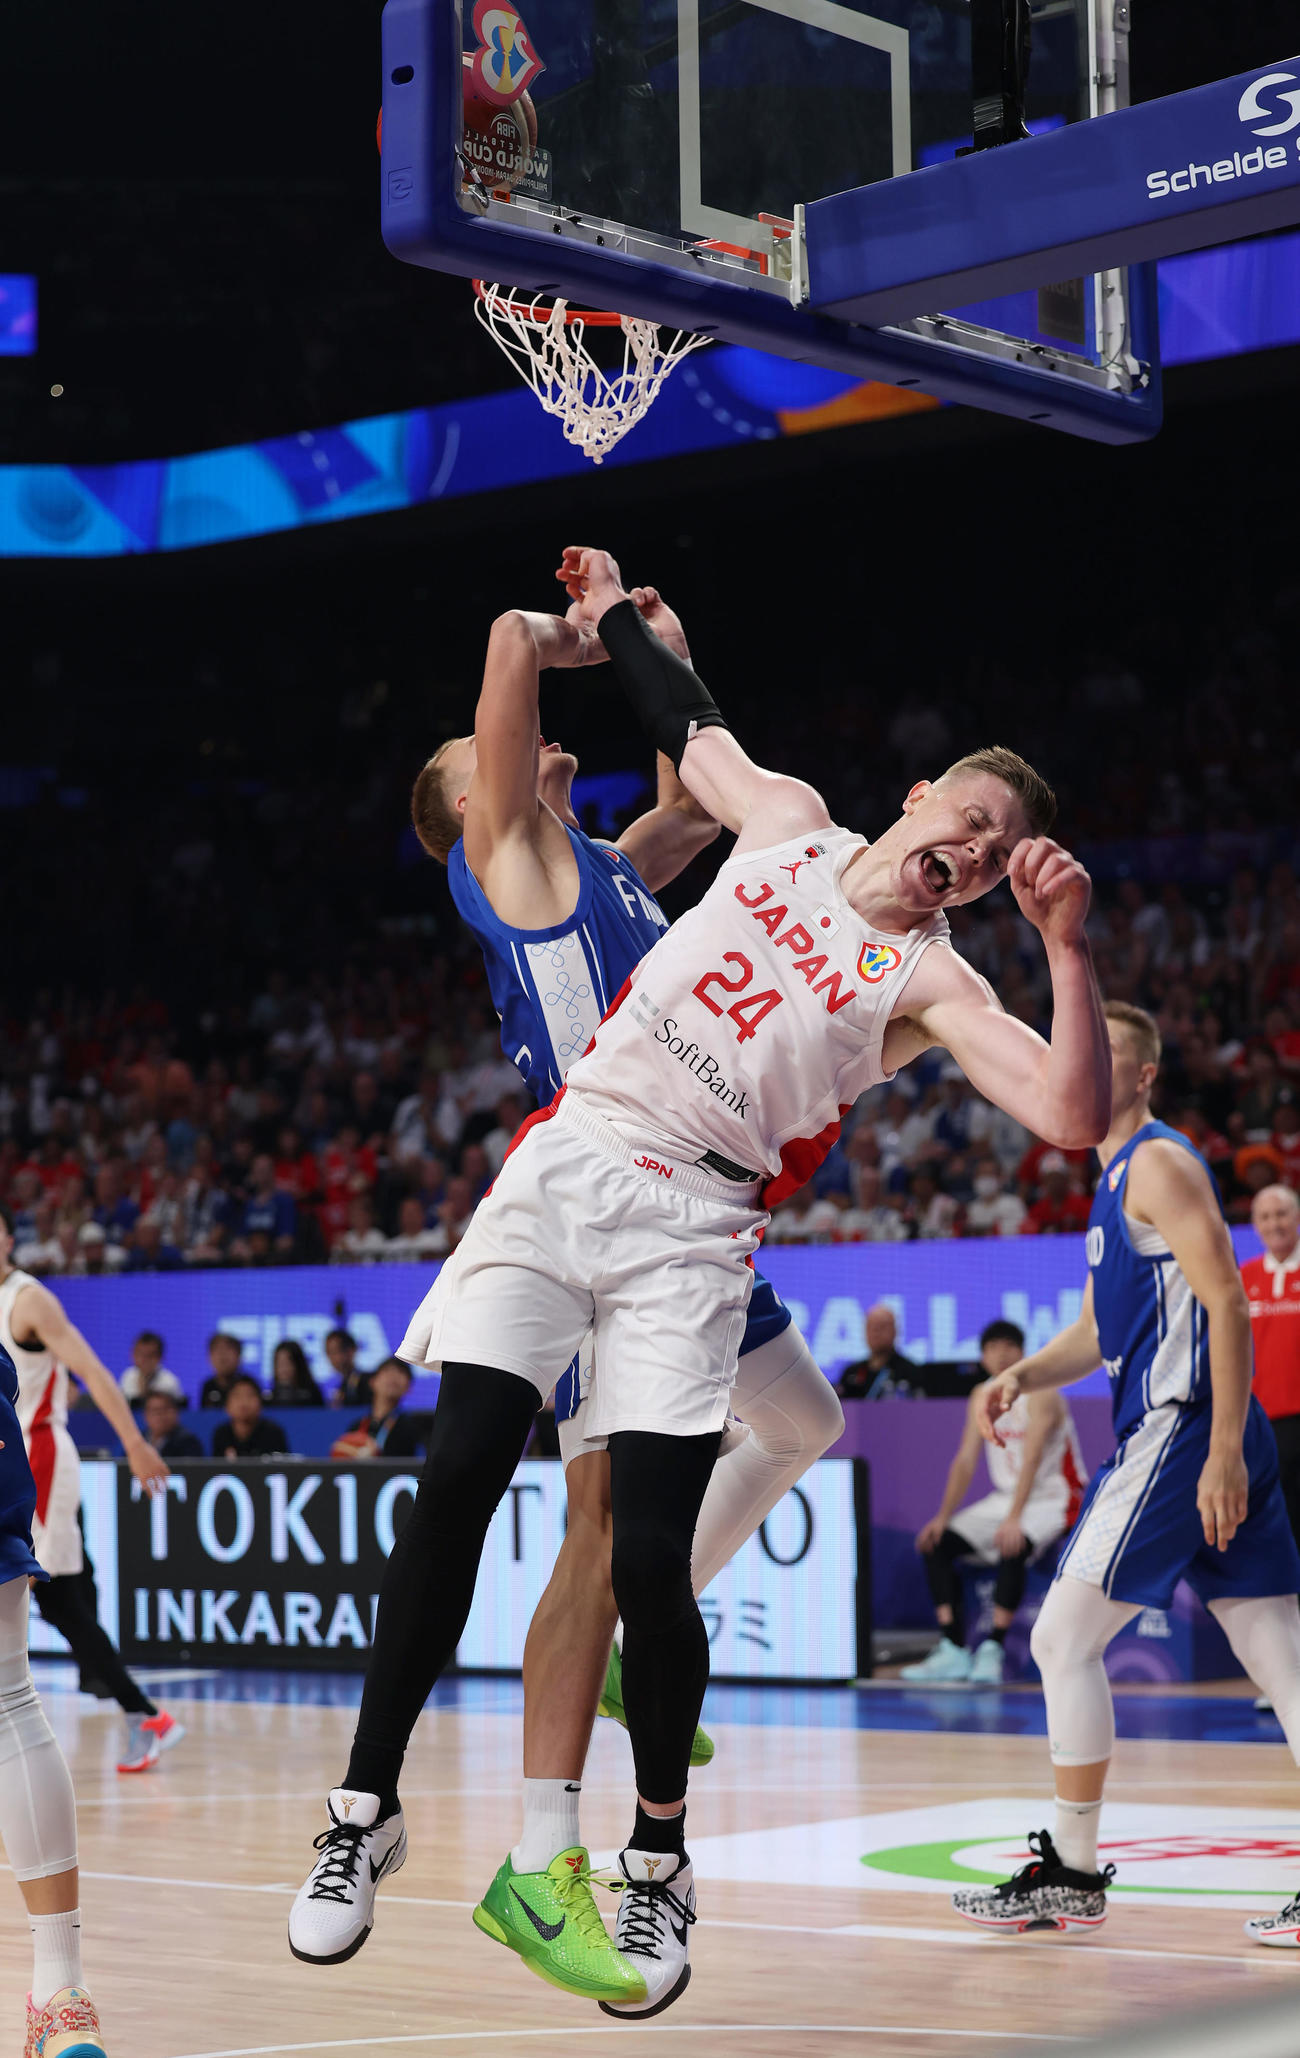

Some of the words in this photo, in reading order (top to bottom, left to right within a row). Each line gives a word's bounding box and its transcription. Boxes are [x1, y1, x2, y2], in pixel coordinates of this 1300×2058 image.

[1146, 145, 1288, 199] Schelde
[733, 882, 858, 1015] JAPAN
[691, 951, 784, 1045] 24
[653, 1018, 751, 1120] SoftBank
[633, 1155, 674, 1179] JPN
[133, 1587, 380, 1649] INKARA
